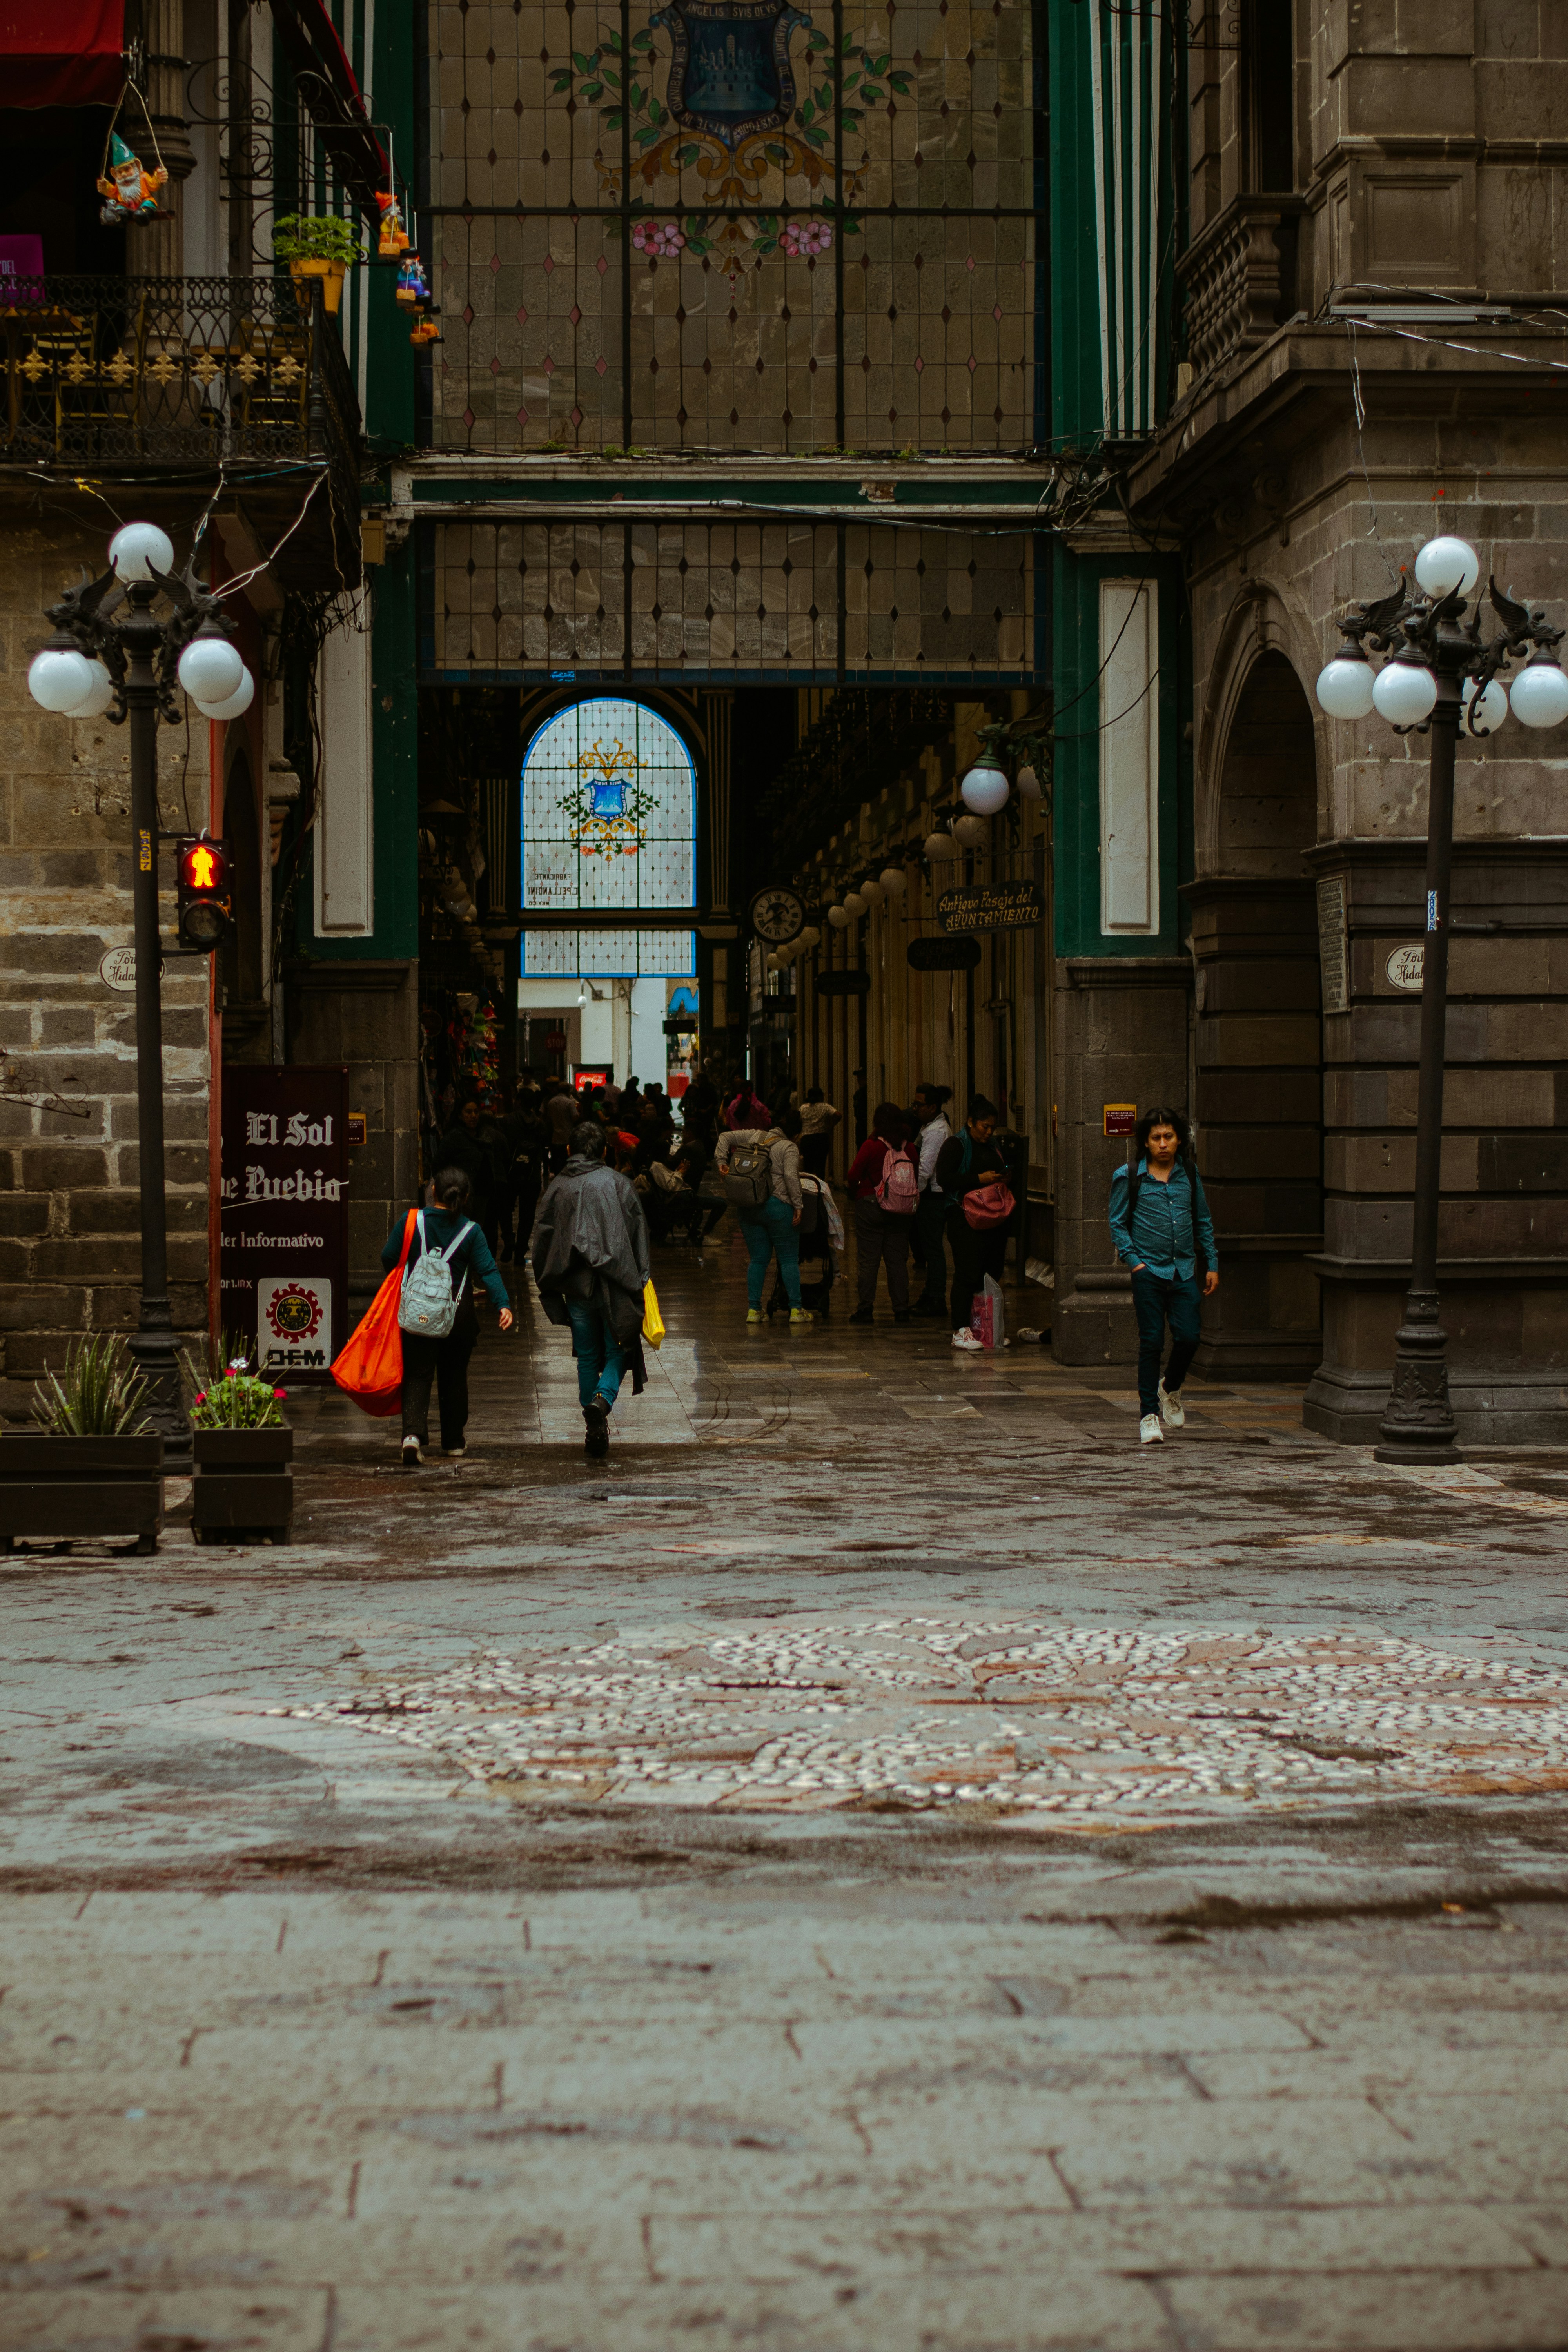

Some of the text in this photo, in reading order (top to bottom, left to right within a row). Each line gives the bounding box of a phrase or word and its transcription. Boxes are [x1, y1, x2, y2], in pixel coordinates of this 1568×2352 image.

[686, 3, 777, 18] ANGELIS SVIS DEVS
[779, 65, 790, 77] DE
[939, 886, 1033, 914] Antiguo Pasaje del
[946, 906, 1039, 927] AYUNTAMIENTO
[547, 1038, 565, 1047] STOP
[246, 1111, 334, 1147] El Sol
[241, 1231, 324, 1248] Informativo
